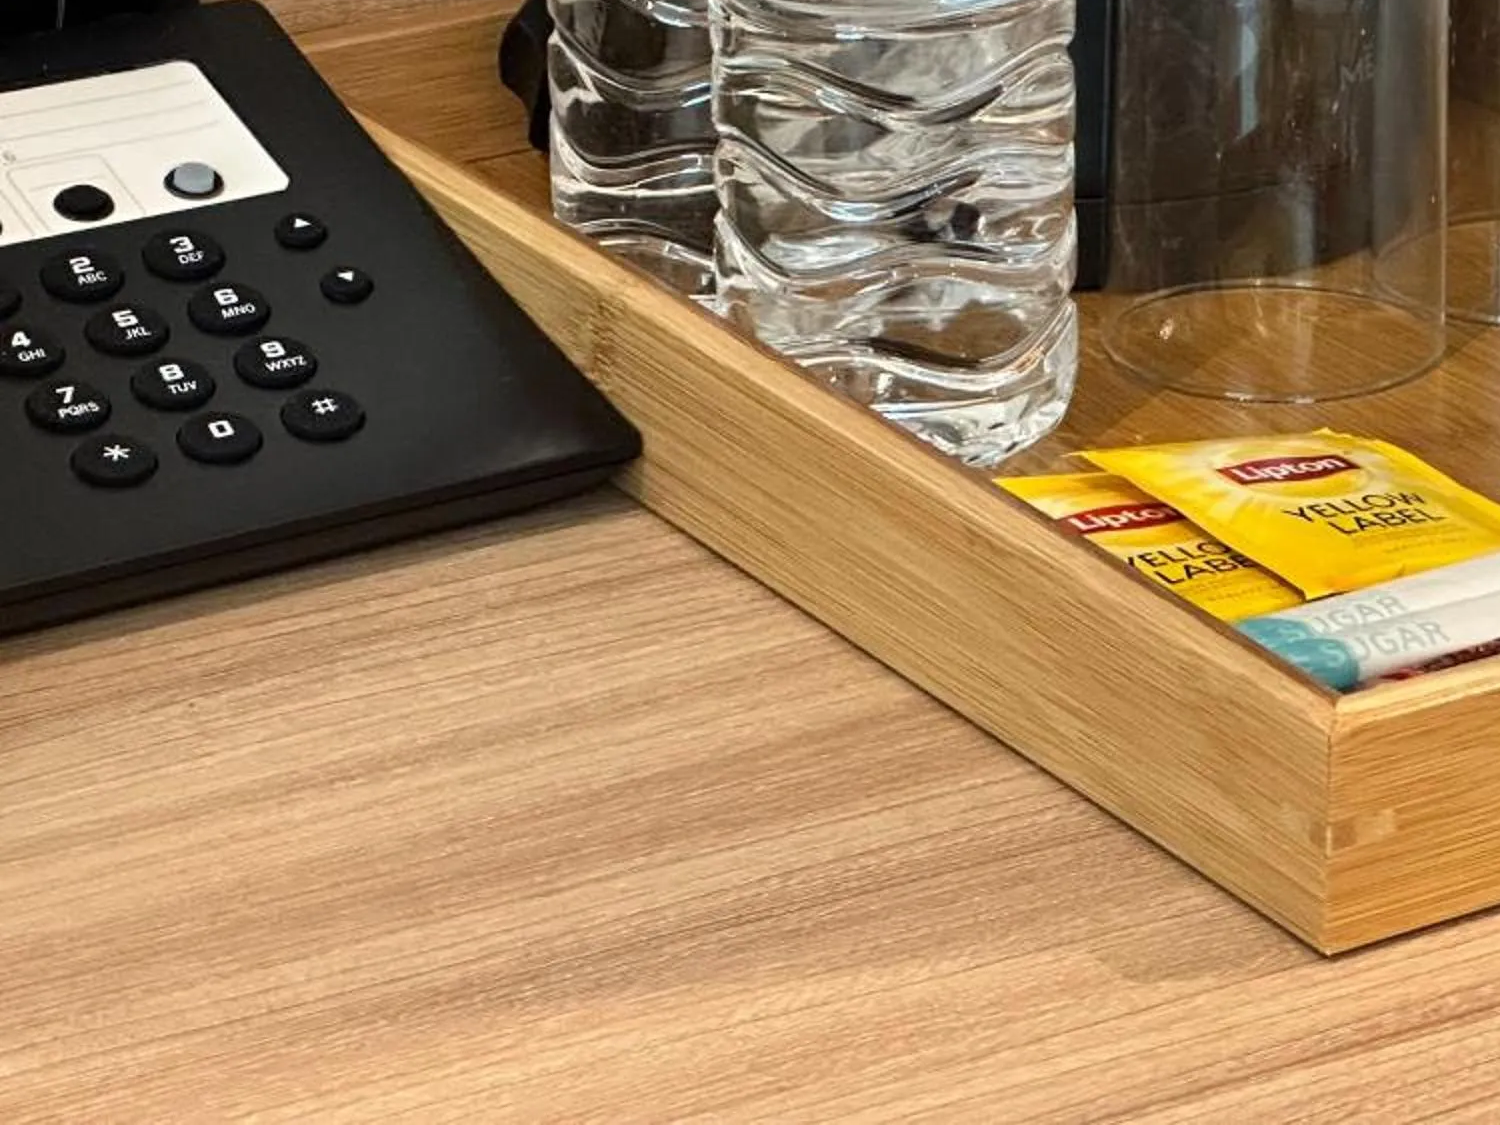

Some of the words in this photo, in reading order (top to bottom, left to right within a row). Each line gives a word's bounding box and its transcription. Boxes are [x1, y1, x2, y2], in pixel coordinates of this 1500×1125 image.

[169, 236, 195, 254] 3
[69, 256, 95, 274] 2
[177, 250, 204, 264] DEF
[78, 270, 107, 286] ABC
[213, 288, 239, 306] 6
[111, 309, 139, 328] 5
[221, 303, 256, 319] MNO
[11, 331, 31, 348] 4
[125, 326, 152, 340] JKL
[17, 348, 46, 362] GHI
[260, 340, 286, 358] 9
[159, 363, 184, 382] 8
[265, 355, 307, 372] WXYZ
[55, 386, 75, 404] 7
[167, 380, 197, 395] TUV
[57, 401, 100, 419] PQRS
[208, 420, 235, 438] 0
[1231, 456, 1345, 481] Lipton
[1283, 491, 1425, 523] YELLOW
[1328, 508, 1449, 535] LABEL
[1279, 596, 1406, 643] SUGAR
[1319, 621, 1451, 668] SUGAR
